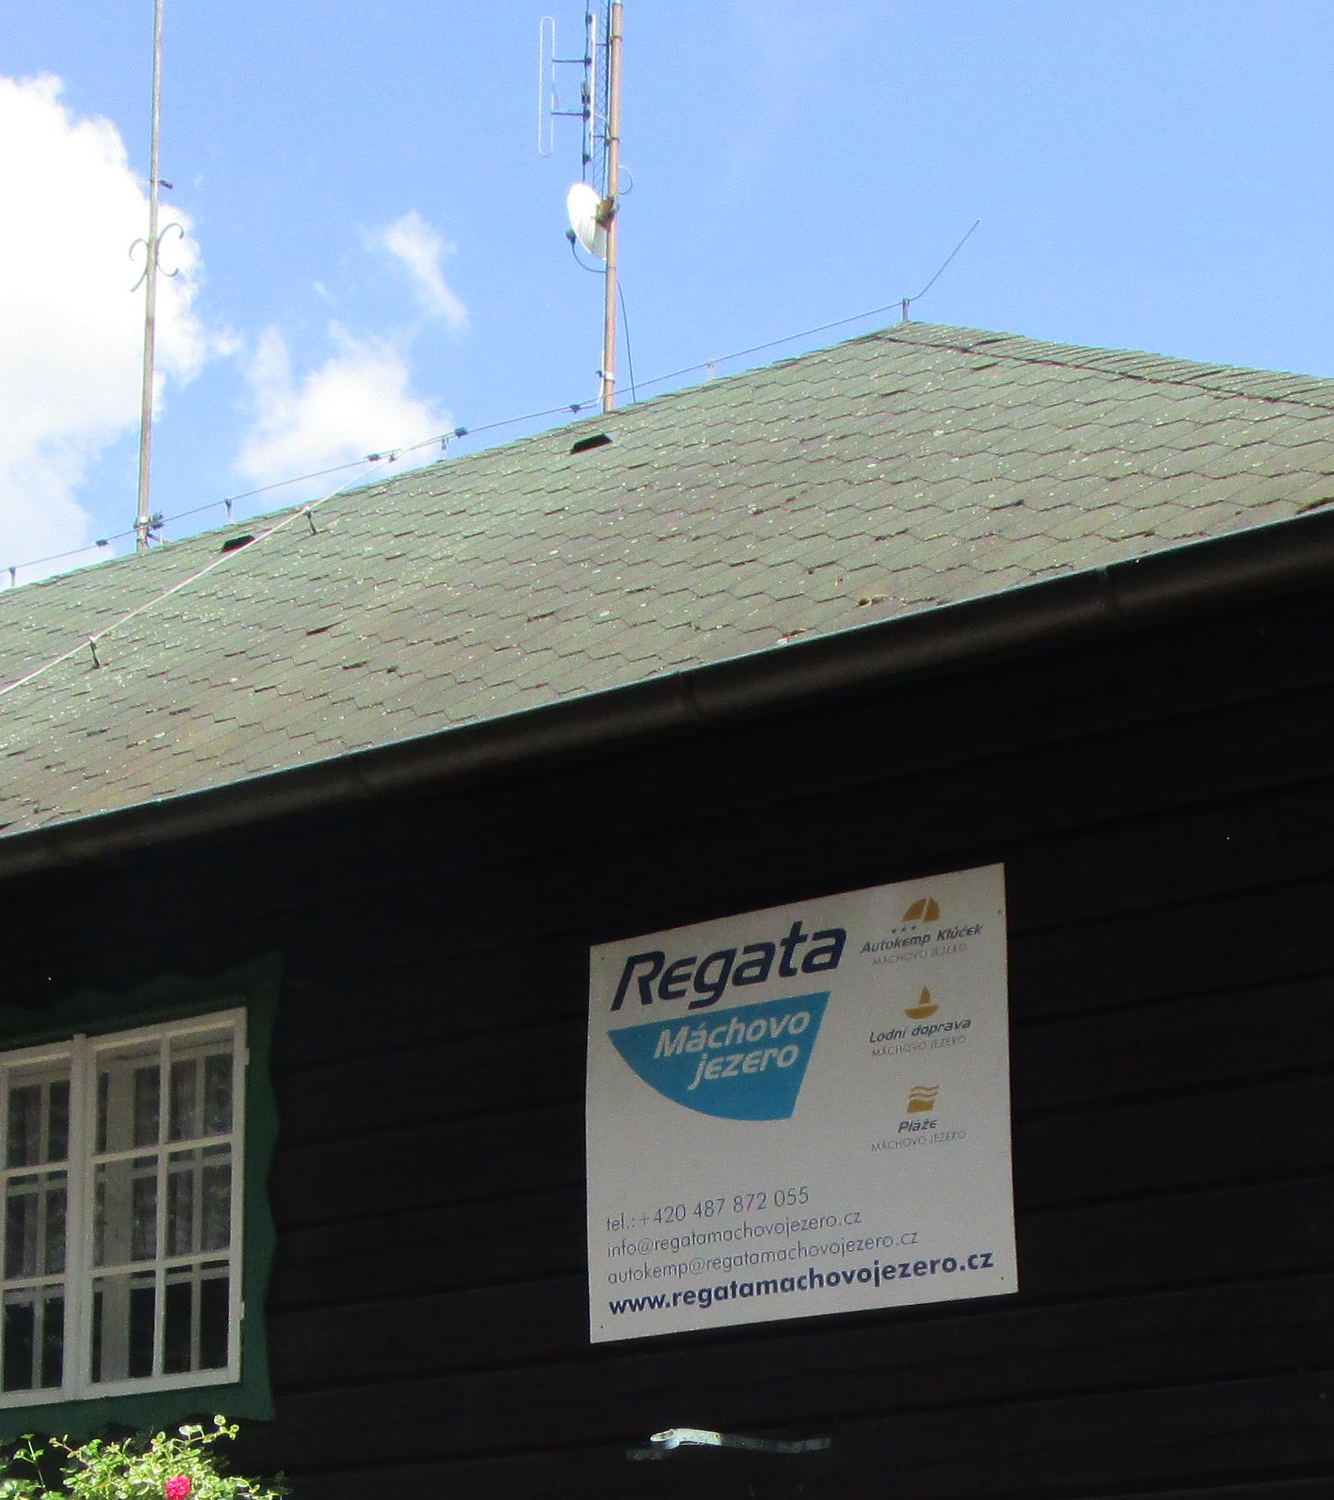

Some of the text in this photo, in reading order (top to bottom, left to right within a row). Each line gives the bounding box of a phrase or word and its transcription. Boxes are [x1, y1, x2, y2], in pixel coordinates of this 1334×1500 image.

[610, 920, 847, 1012] Regata
[860, 933, 931, 955] Autokemp
[653, 1011, 811, 1060] Máchovo
[911, 1018, 971, 1037] doprava
[687, 1044, 800, 1091] jezero
[929, 1130, 967, 1145] JEZERO
[693, 1199, 725, 1219] 487
[733, 1192, 767, 1213] 872
[774, 1186, 809, 1208] 055
[607, 1211, 862, 1258] info@regatamachovojezero.cz
[608, 1231, 920, 1285] autokemp@regatamachovojezero.cz
[609, 1251, 994, 1315] www.regatamachovojezero.cz
